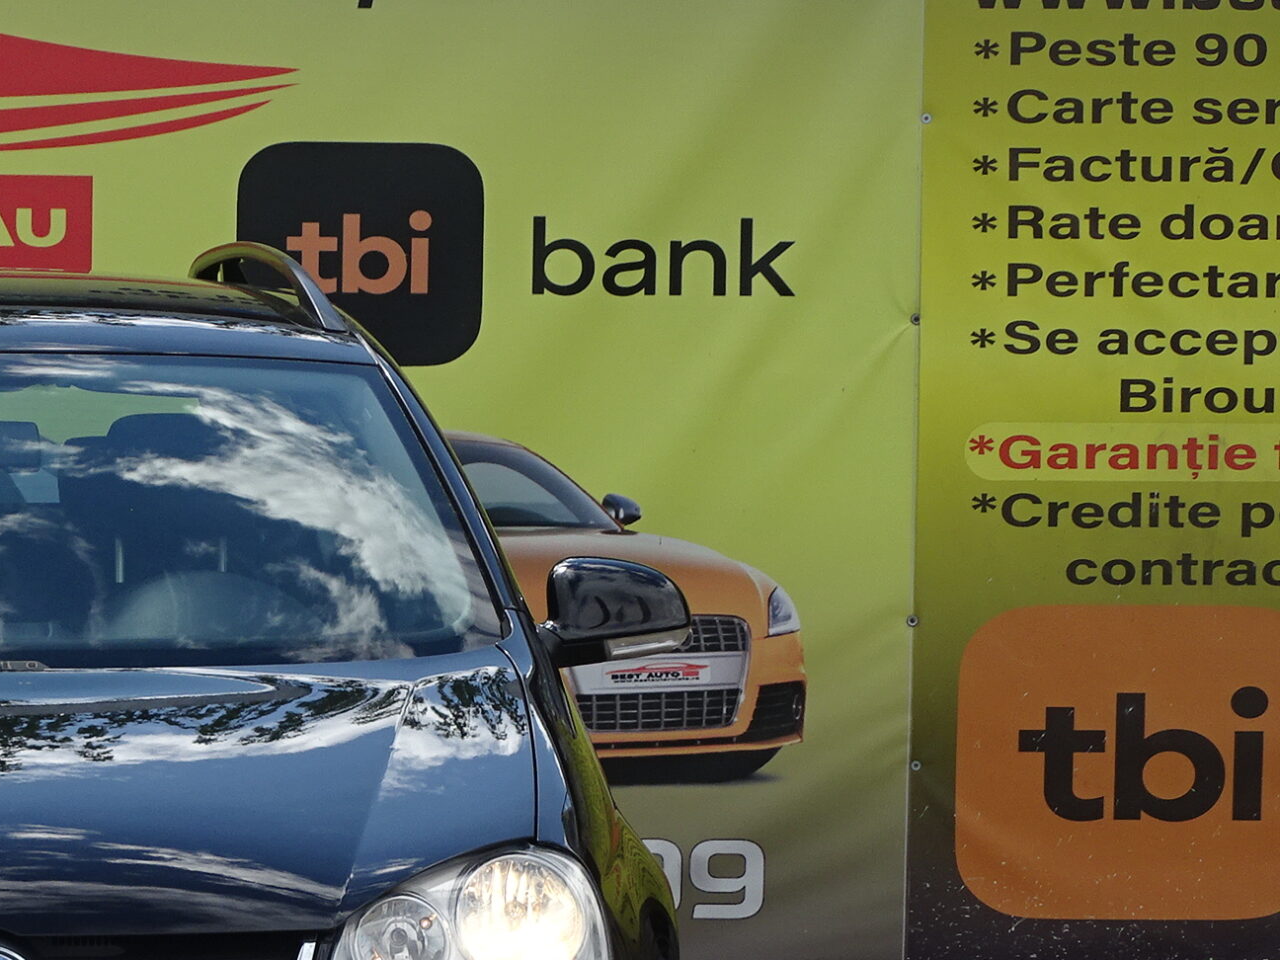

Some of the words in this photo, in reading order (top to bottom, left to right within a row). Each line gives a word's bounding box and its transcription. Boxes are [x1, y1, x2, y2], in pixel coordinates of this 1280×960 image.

[1194, 33, 1268, 67] 90
[972, 146, 1280, 185] Factură/
[1160, 204, 1280, 241] doa
[286, 210, 433, 295] tbi
[531, 215, 796, 297] bank
[1097, 327, 1278, 366] accep
[1119, 376, 1276, 414] Birou
[1240, 499, 1280, 538] p
[1018, 685, 1269, 823] tbi
